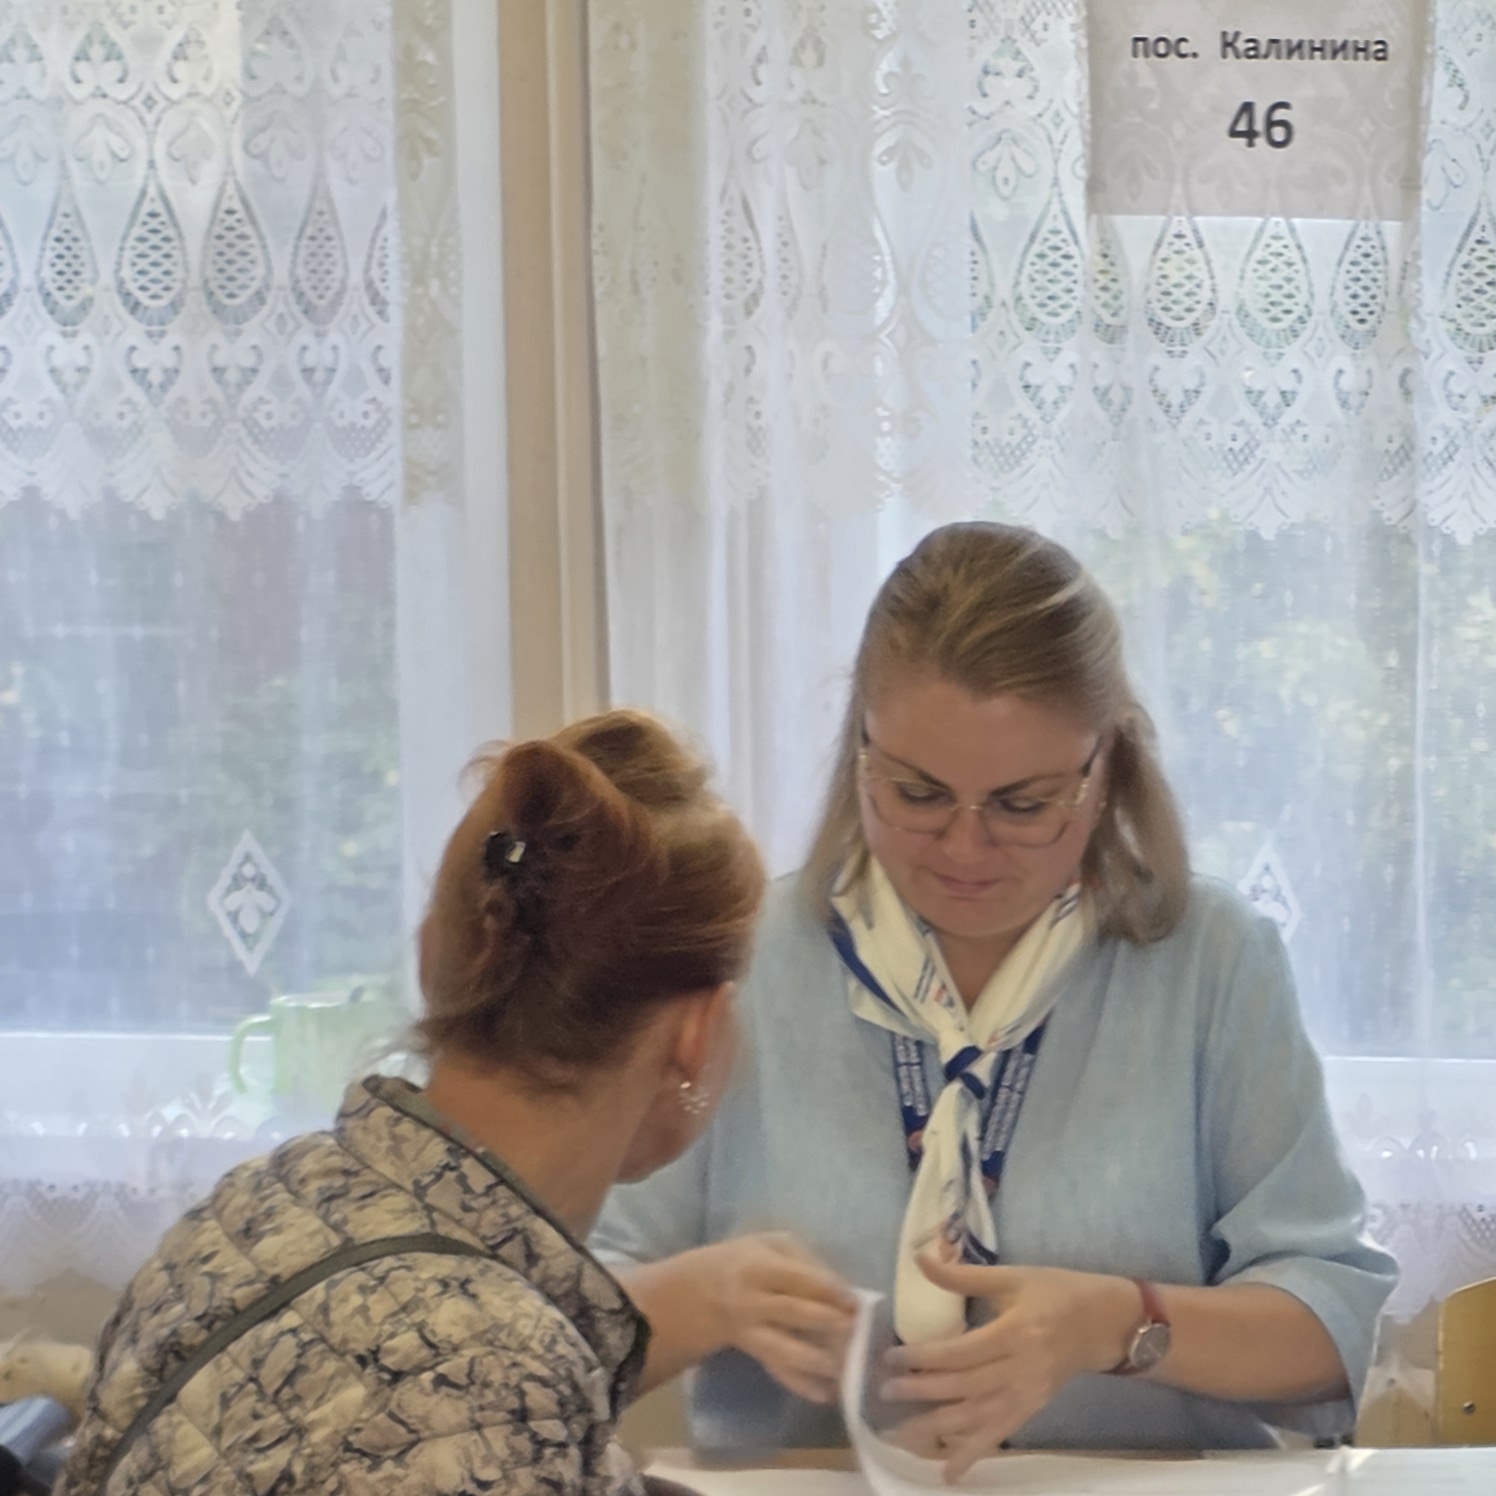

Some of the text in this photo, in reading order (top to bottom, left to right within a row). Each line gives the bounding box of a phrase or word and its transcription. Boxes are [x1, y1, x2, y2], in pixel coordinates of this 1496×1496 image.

[1131, 30, 1390, 62] пос. Калинина
[1227, 101, 1294, 149] 46
